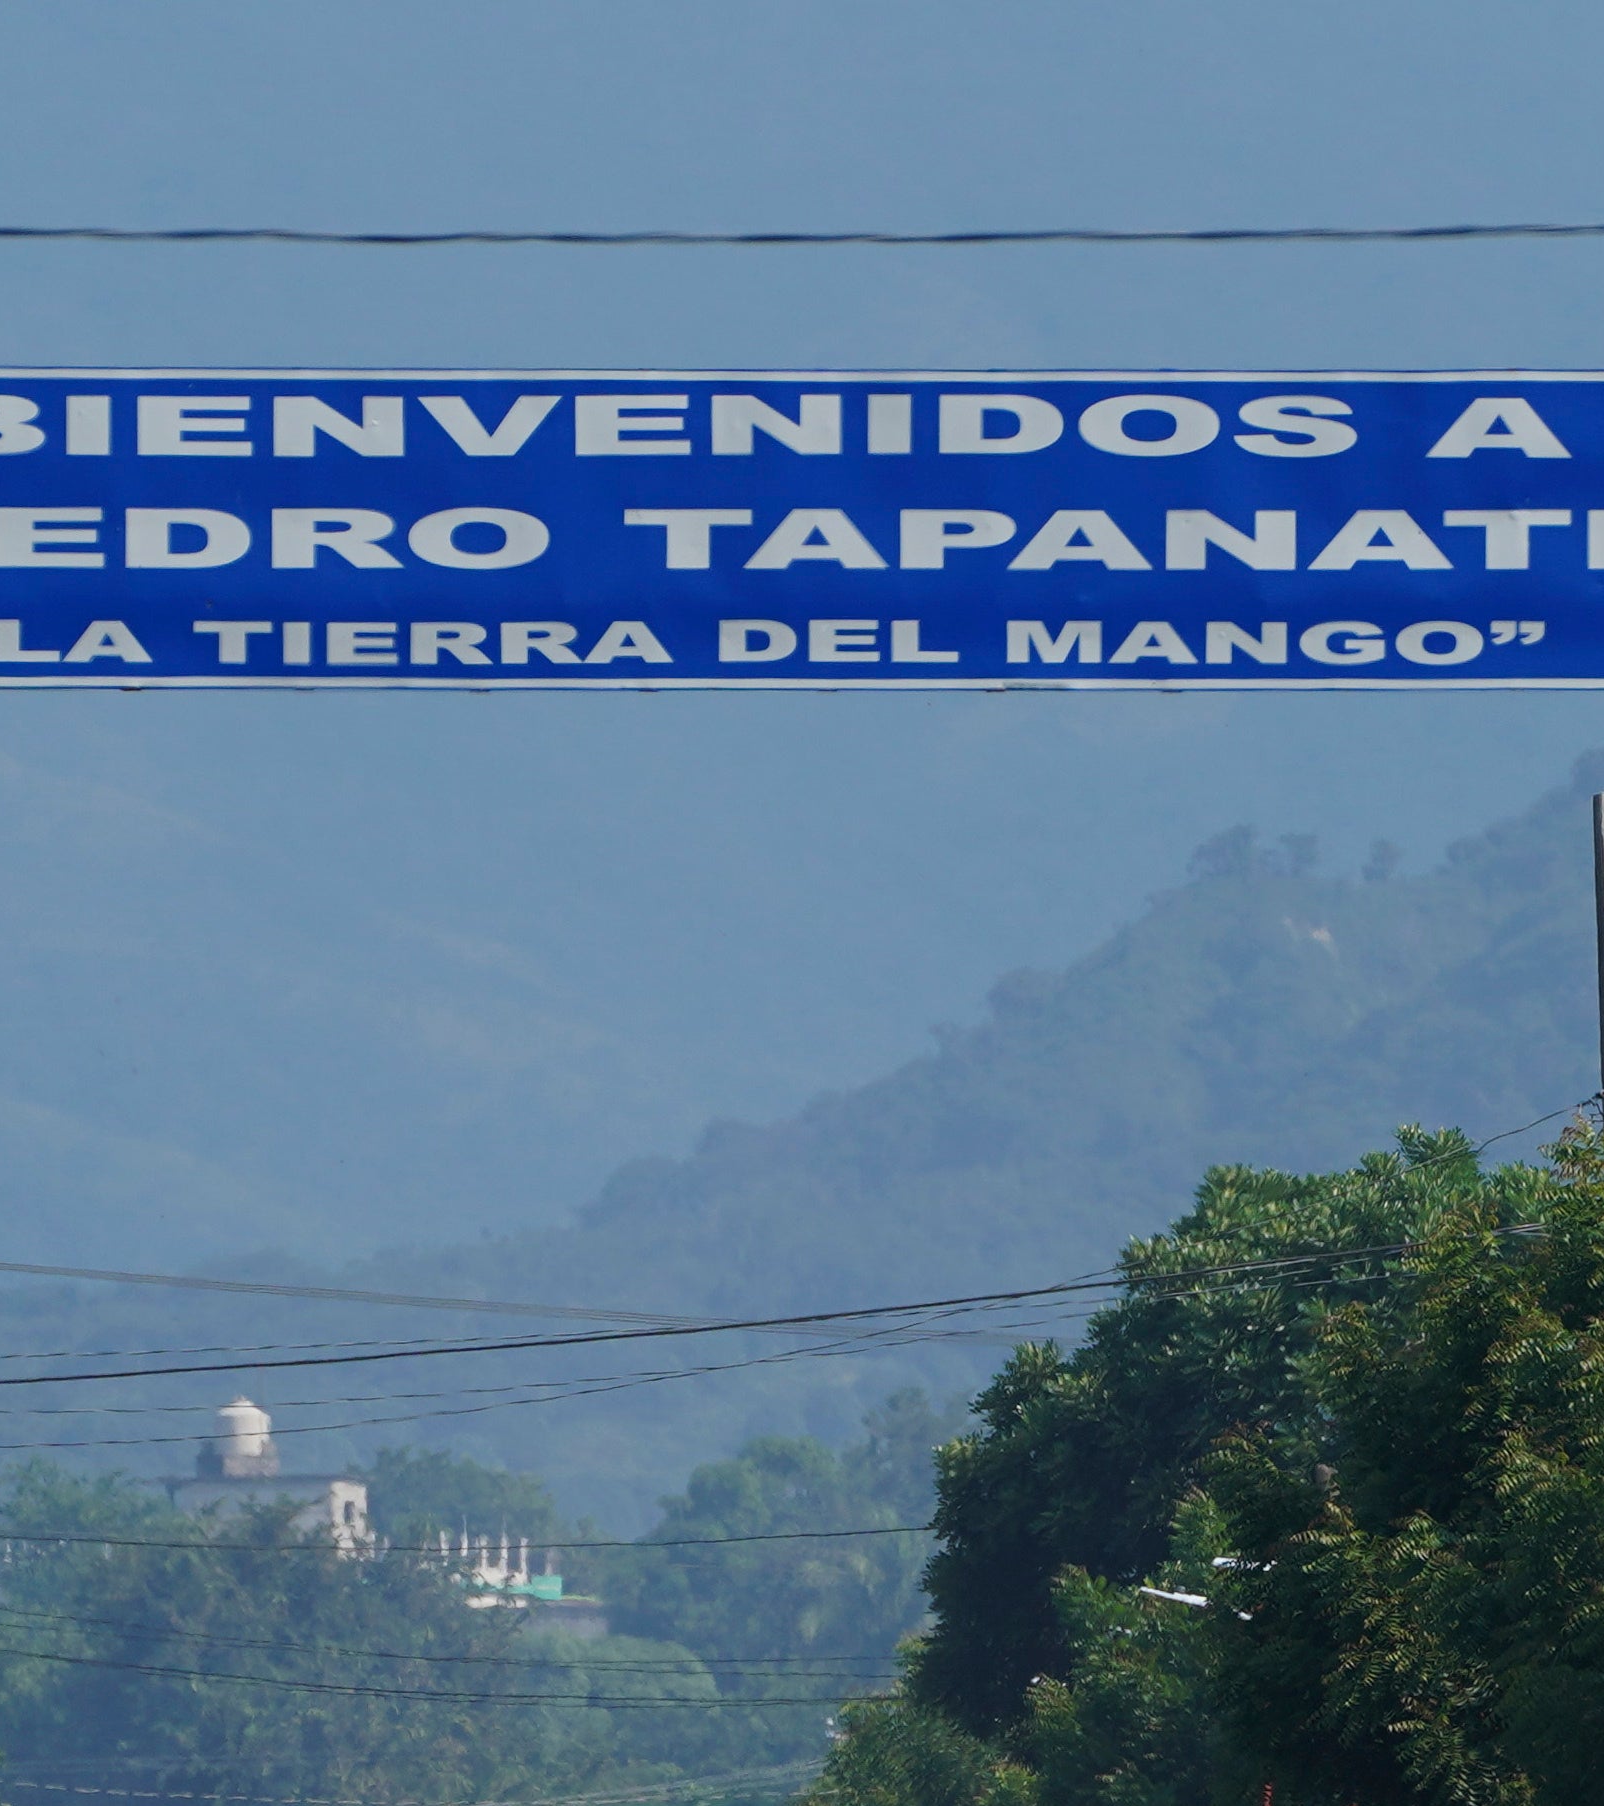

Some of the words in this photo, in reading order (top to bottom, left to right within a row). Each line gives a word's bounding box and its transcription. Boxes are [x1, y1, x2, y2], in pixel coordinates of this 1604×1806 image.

[1428, 397, 1571, 458] A
[194, 620, 672, 664] TIERRA
[719, 620, 958, 662] DEL
[1007, 621, 1545, 664] MANGO”
